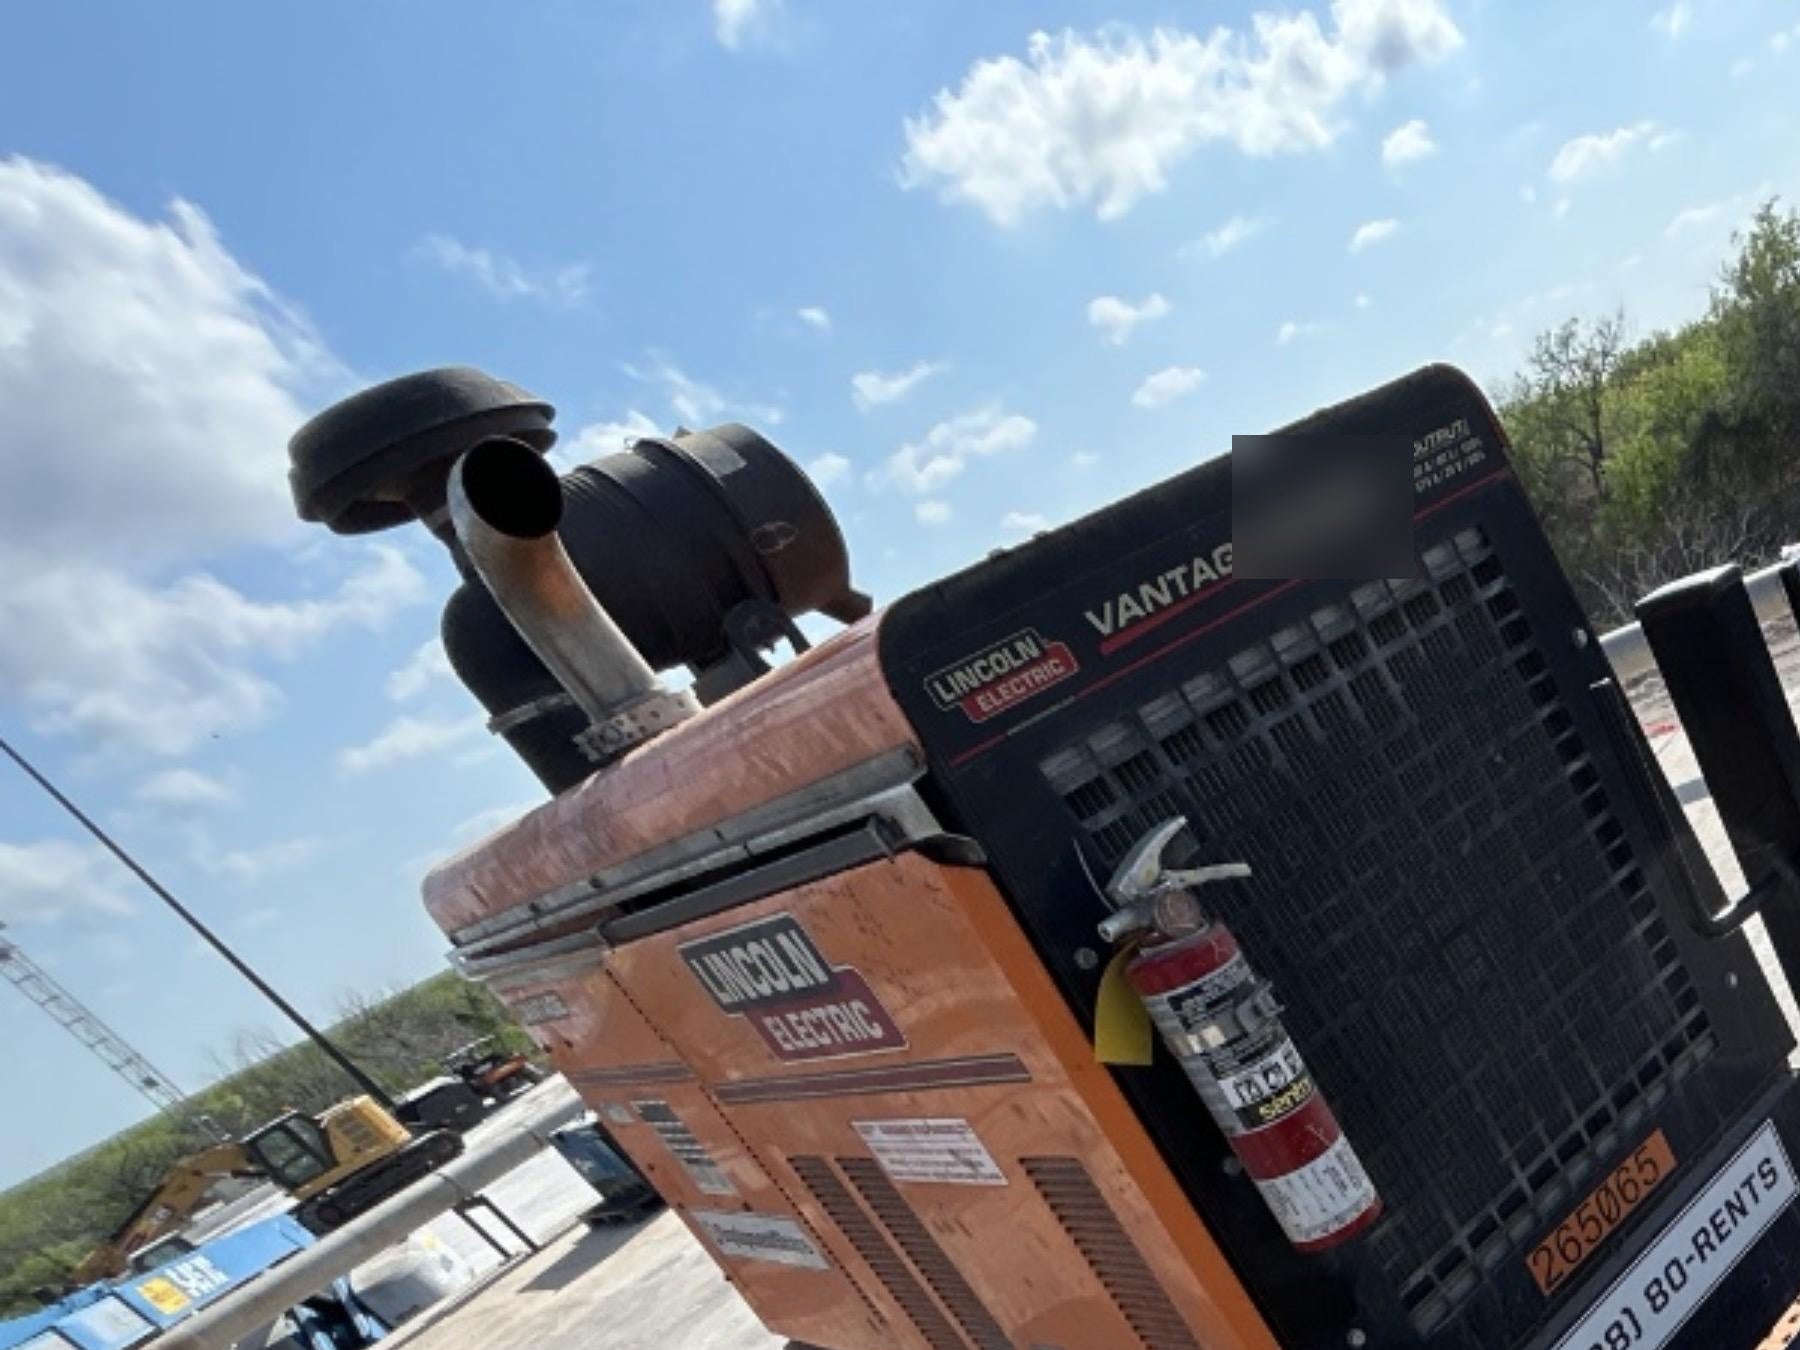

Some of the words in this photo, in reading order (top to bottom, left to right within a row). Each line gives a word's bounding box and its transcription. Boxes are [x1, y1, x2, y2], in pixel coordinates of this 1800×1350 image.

[1084, 542, 1233, 636] VANTAG
[933, 635, 1041, 702] LINCOLN
[976, 658, 1065, 714] ELECTRIC
[690, 929, 830, 1005] LINCOLN
[762, 999, 884, 1051] ELECTRIC
[1532, 1144, 1660, 1289] 265065
[1643, 1157, 1779, 1315] 80-RENTS
